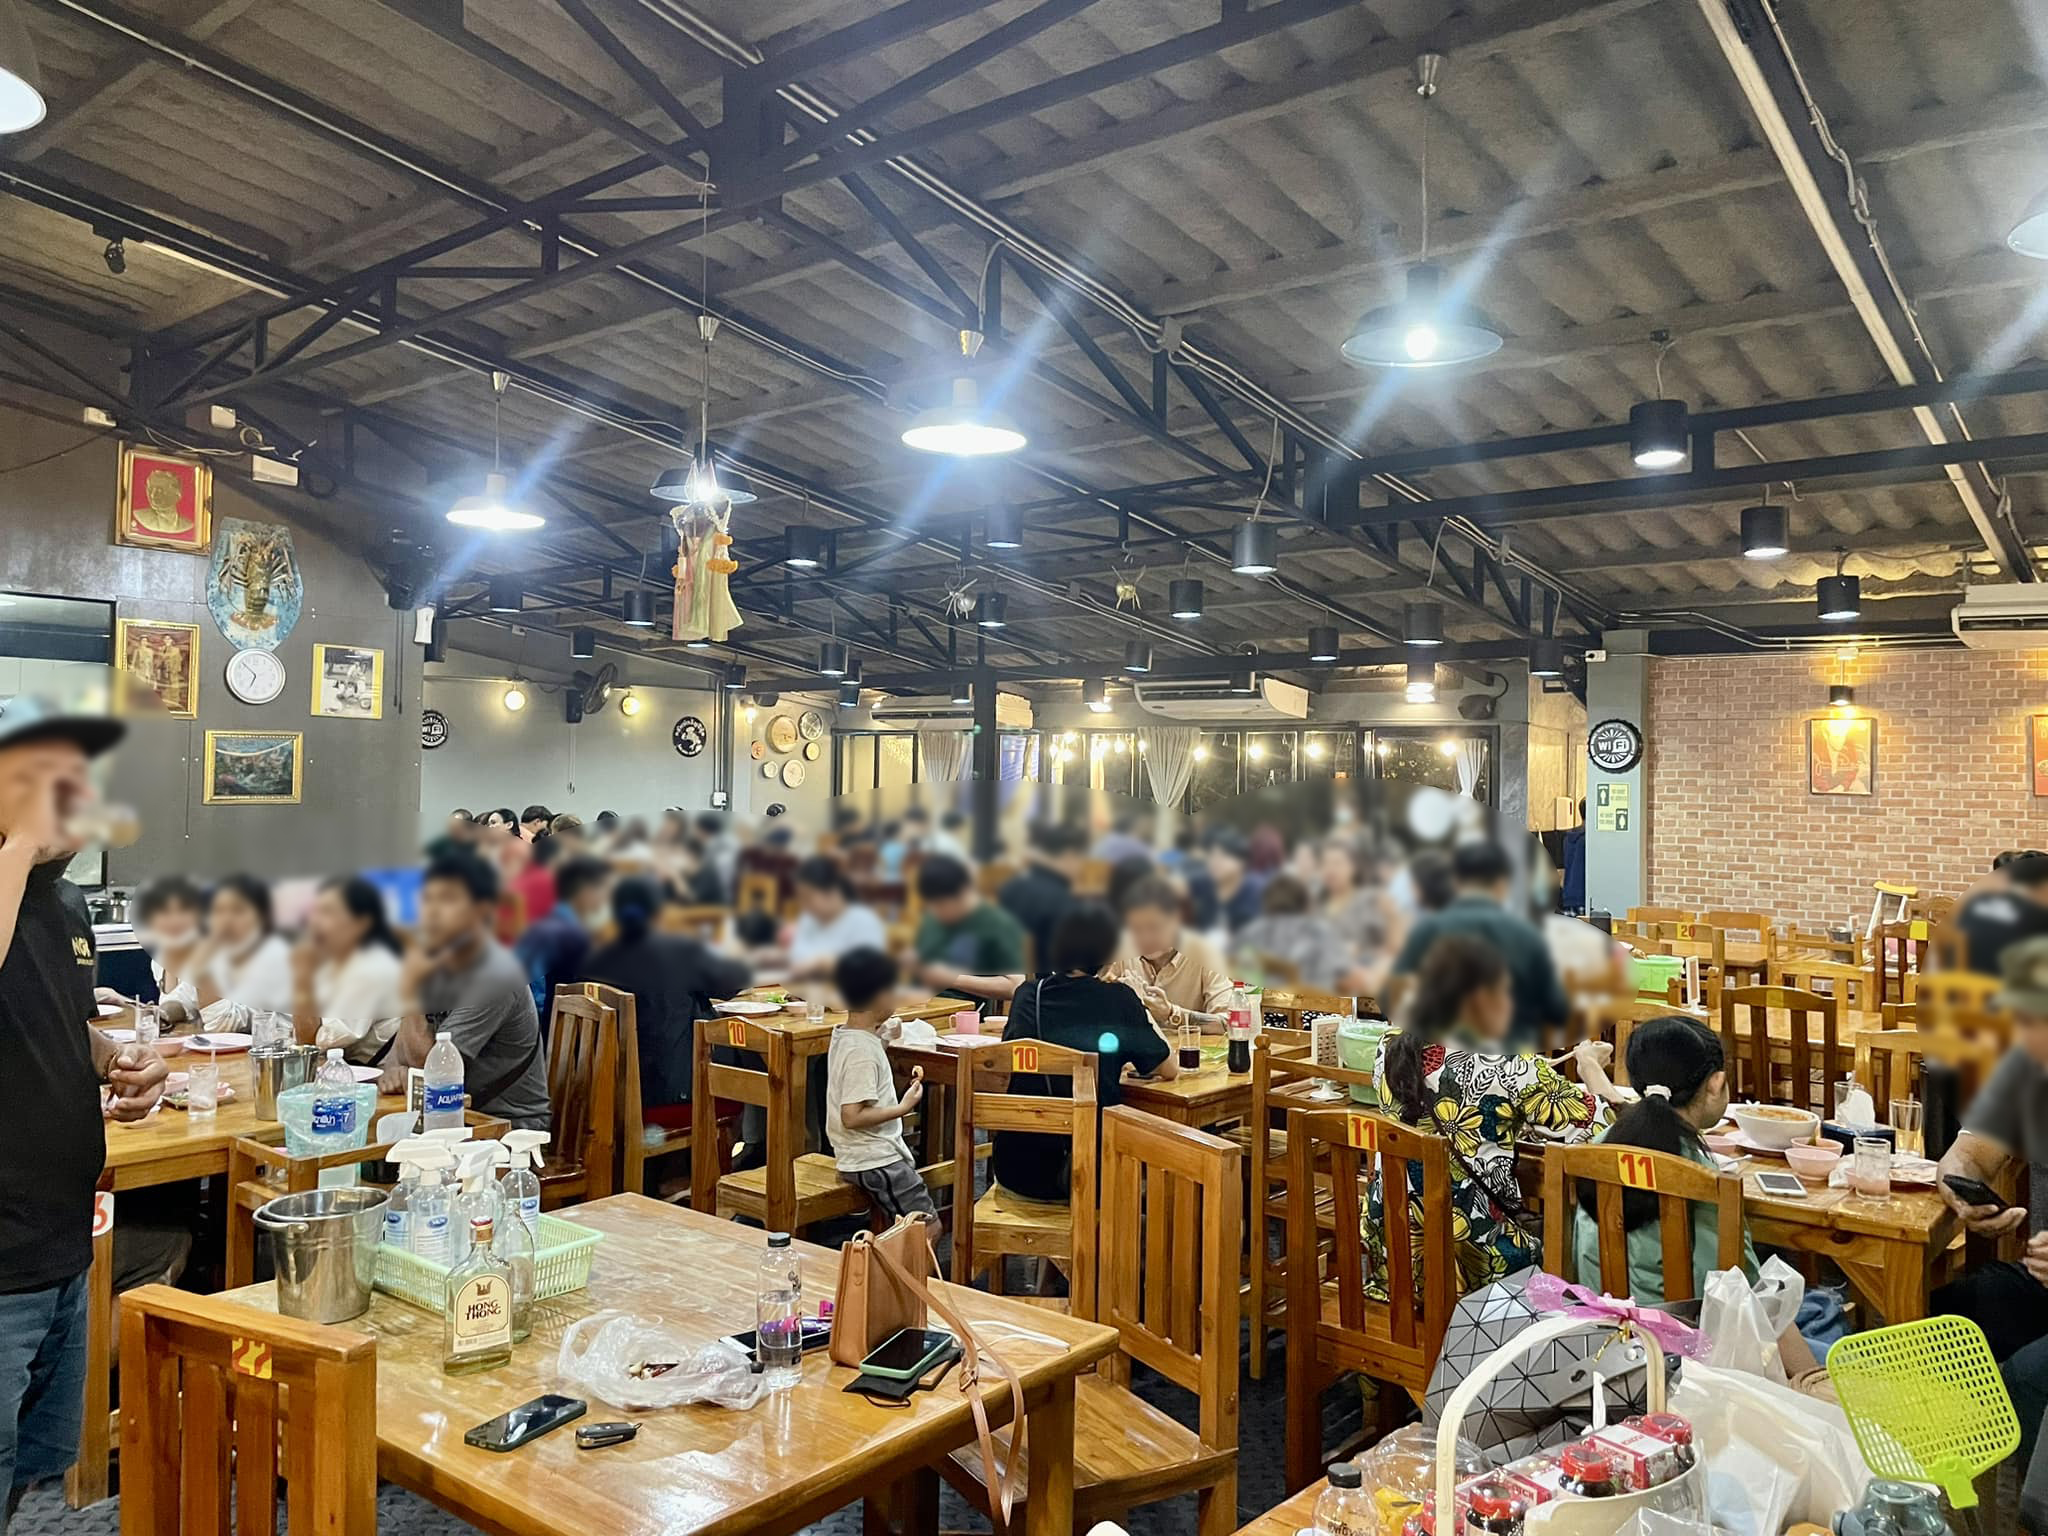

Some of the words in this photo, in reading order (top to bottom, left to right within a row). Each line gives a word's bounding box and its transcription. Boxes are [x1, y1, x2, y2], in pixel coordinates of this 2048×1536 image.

[1681, 925, 1696, 938] 20
[730, 1022, 745, 1045] 10
[1015, 1047, 1037, 1070] 10
[1351, 1116, 1375, 1150] 11
[1621, 1153, 1654, 1188] 11
[465, 1305, 502, 1321] THONG
[468, 1299, 500, 1314] HONG
